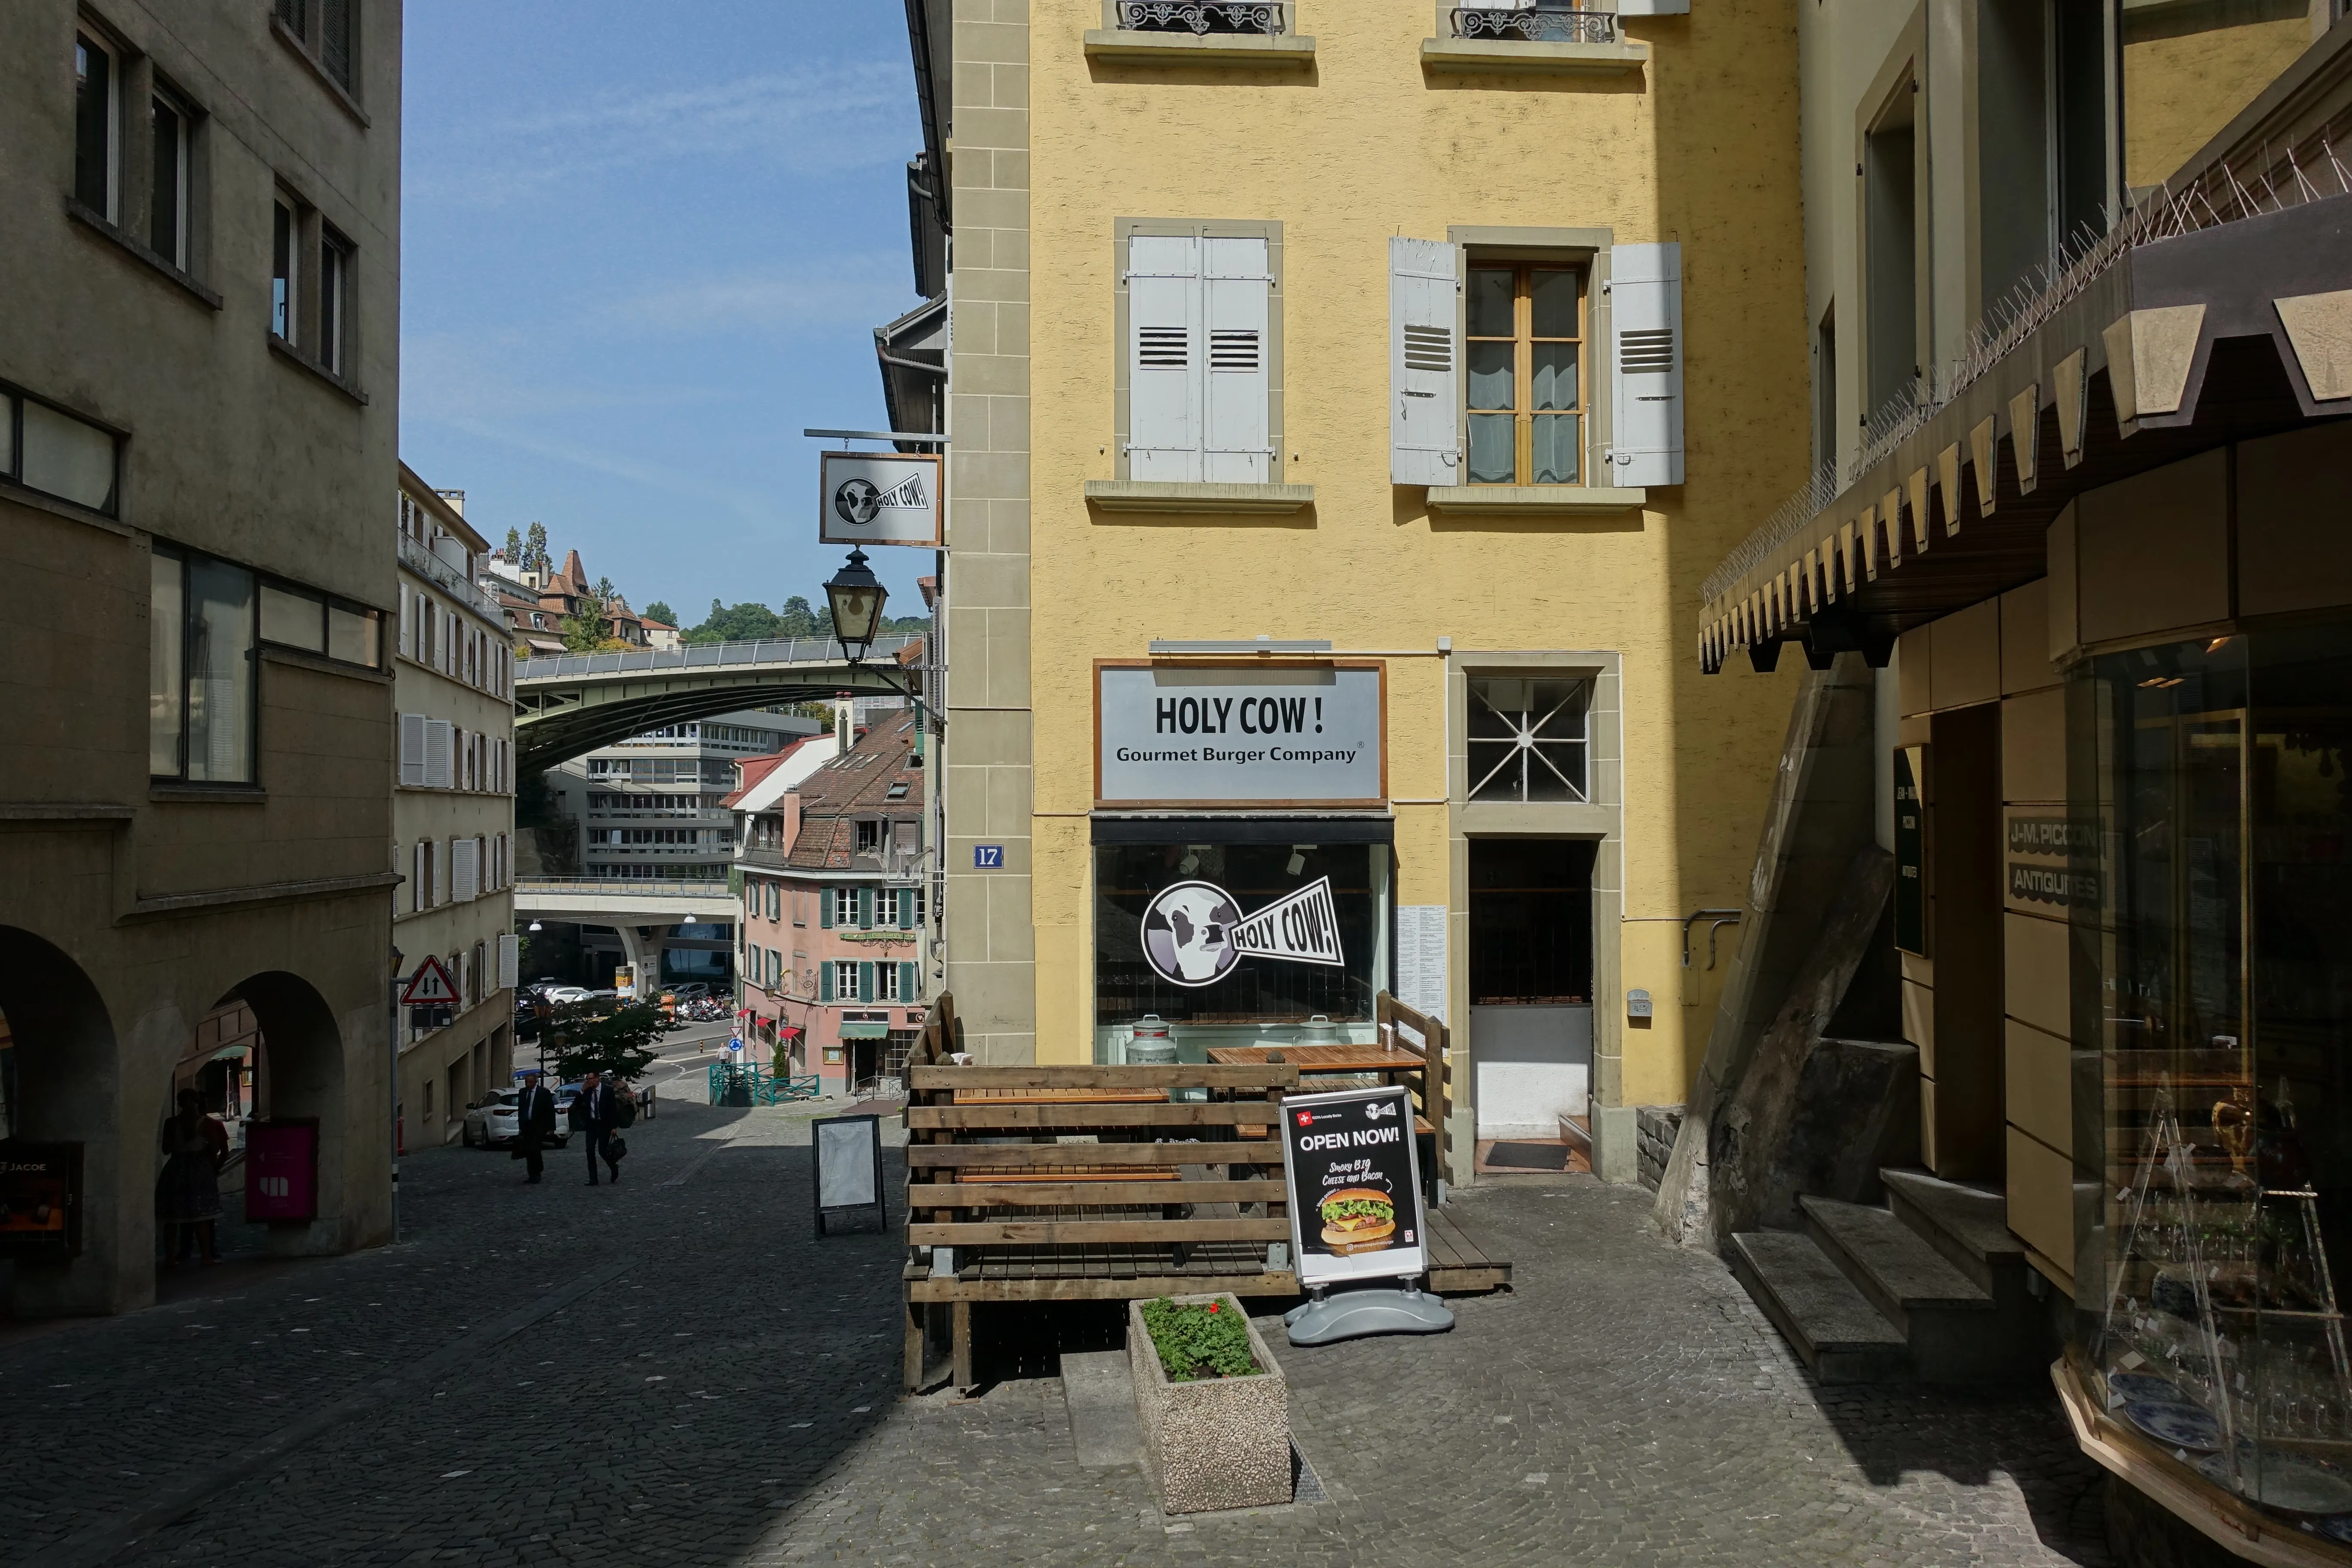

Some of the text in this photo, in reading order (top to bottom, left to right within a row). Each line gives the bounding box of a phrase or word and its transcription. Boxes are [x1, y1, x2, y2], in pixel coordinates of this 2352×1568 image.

[877, 478, 925, 506] HOLY COW!
[1156, 697, 1233, 734] HOLY
[1117, 747, 1357, 764] Gourmet Burger Company
[979, 848, 998, 865] 17
[1234, 891, 1333, 955] HOLY COW!
[1300, 1127, 1400, 1152] OPEN NOW!
